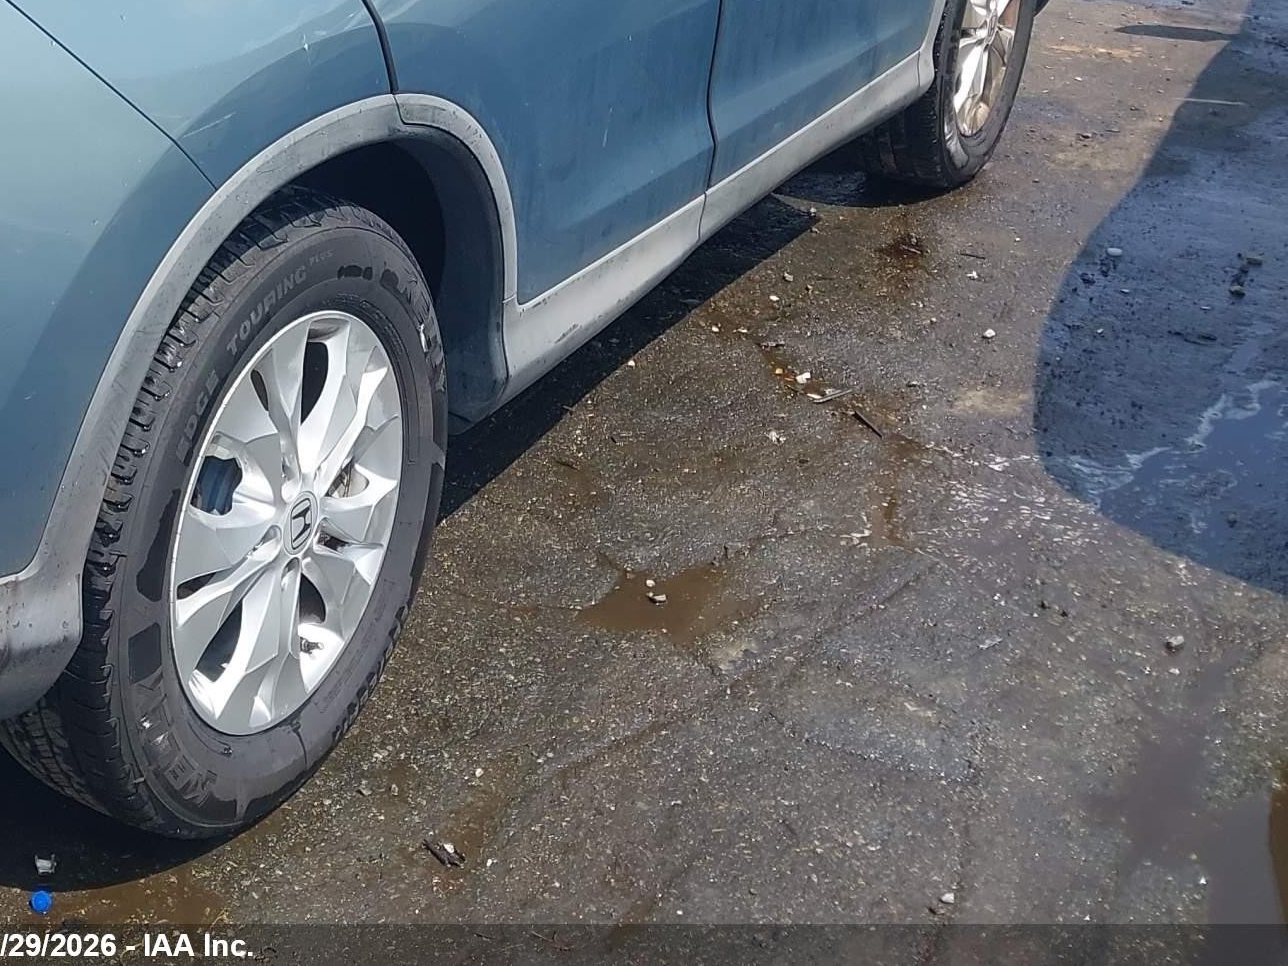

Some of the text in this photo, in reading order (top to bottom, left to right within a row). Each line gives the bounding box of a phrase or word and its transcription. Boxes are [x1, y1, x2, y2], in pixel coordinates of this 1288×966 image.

[175, 249, 334, 463] EDGE TOURING PLUS
